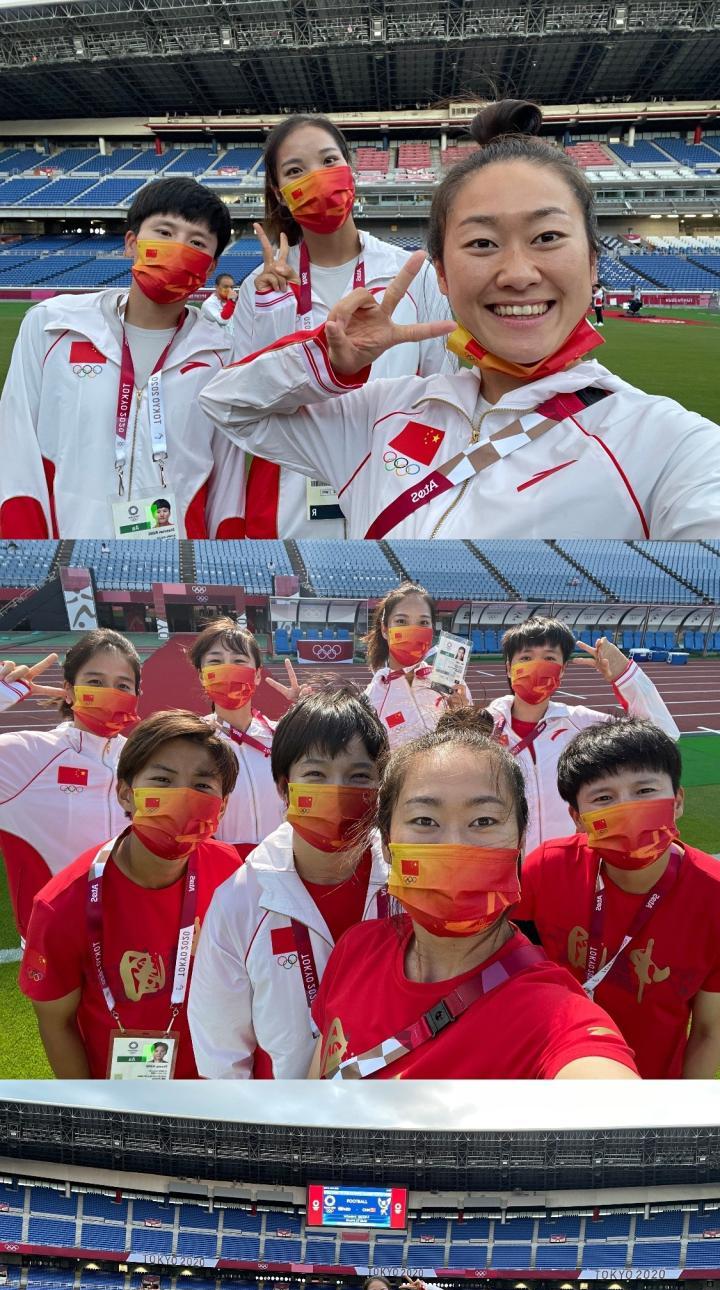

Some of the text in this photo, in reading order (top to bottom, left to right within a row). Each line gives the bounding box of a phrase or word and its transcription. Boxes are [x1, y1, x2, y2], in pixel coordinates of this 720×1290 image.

[144, 1255, 205, 1267] TOKYO 2020
[368, 1268, 424, 1277] TOKYO 2020
[595, 1270, 666, 1279] TOKYO 2020
